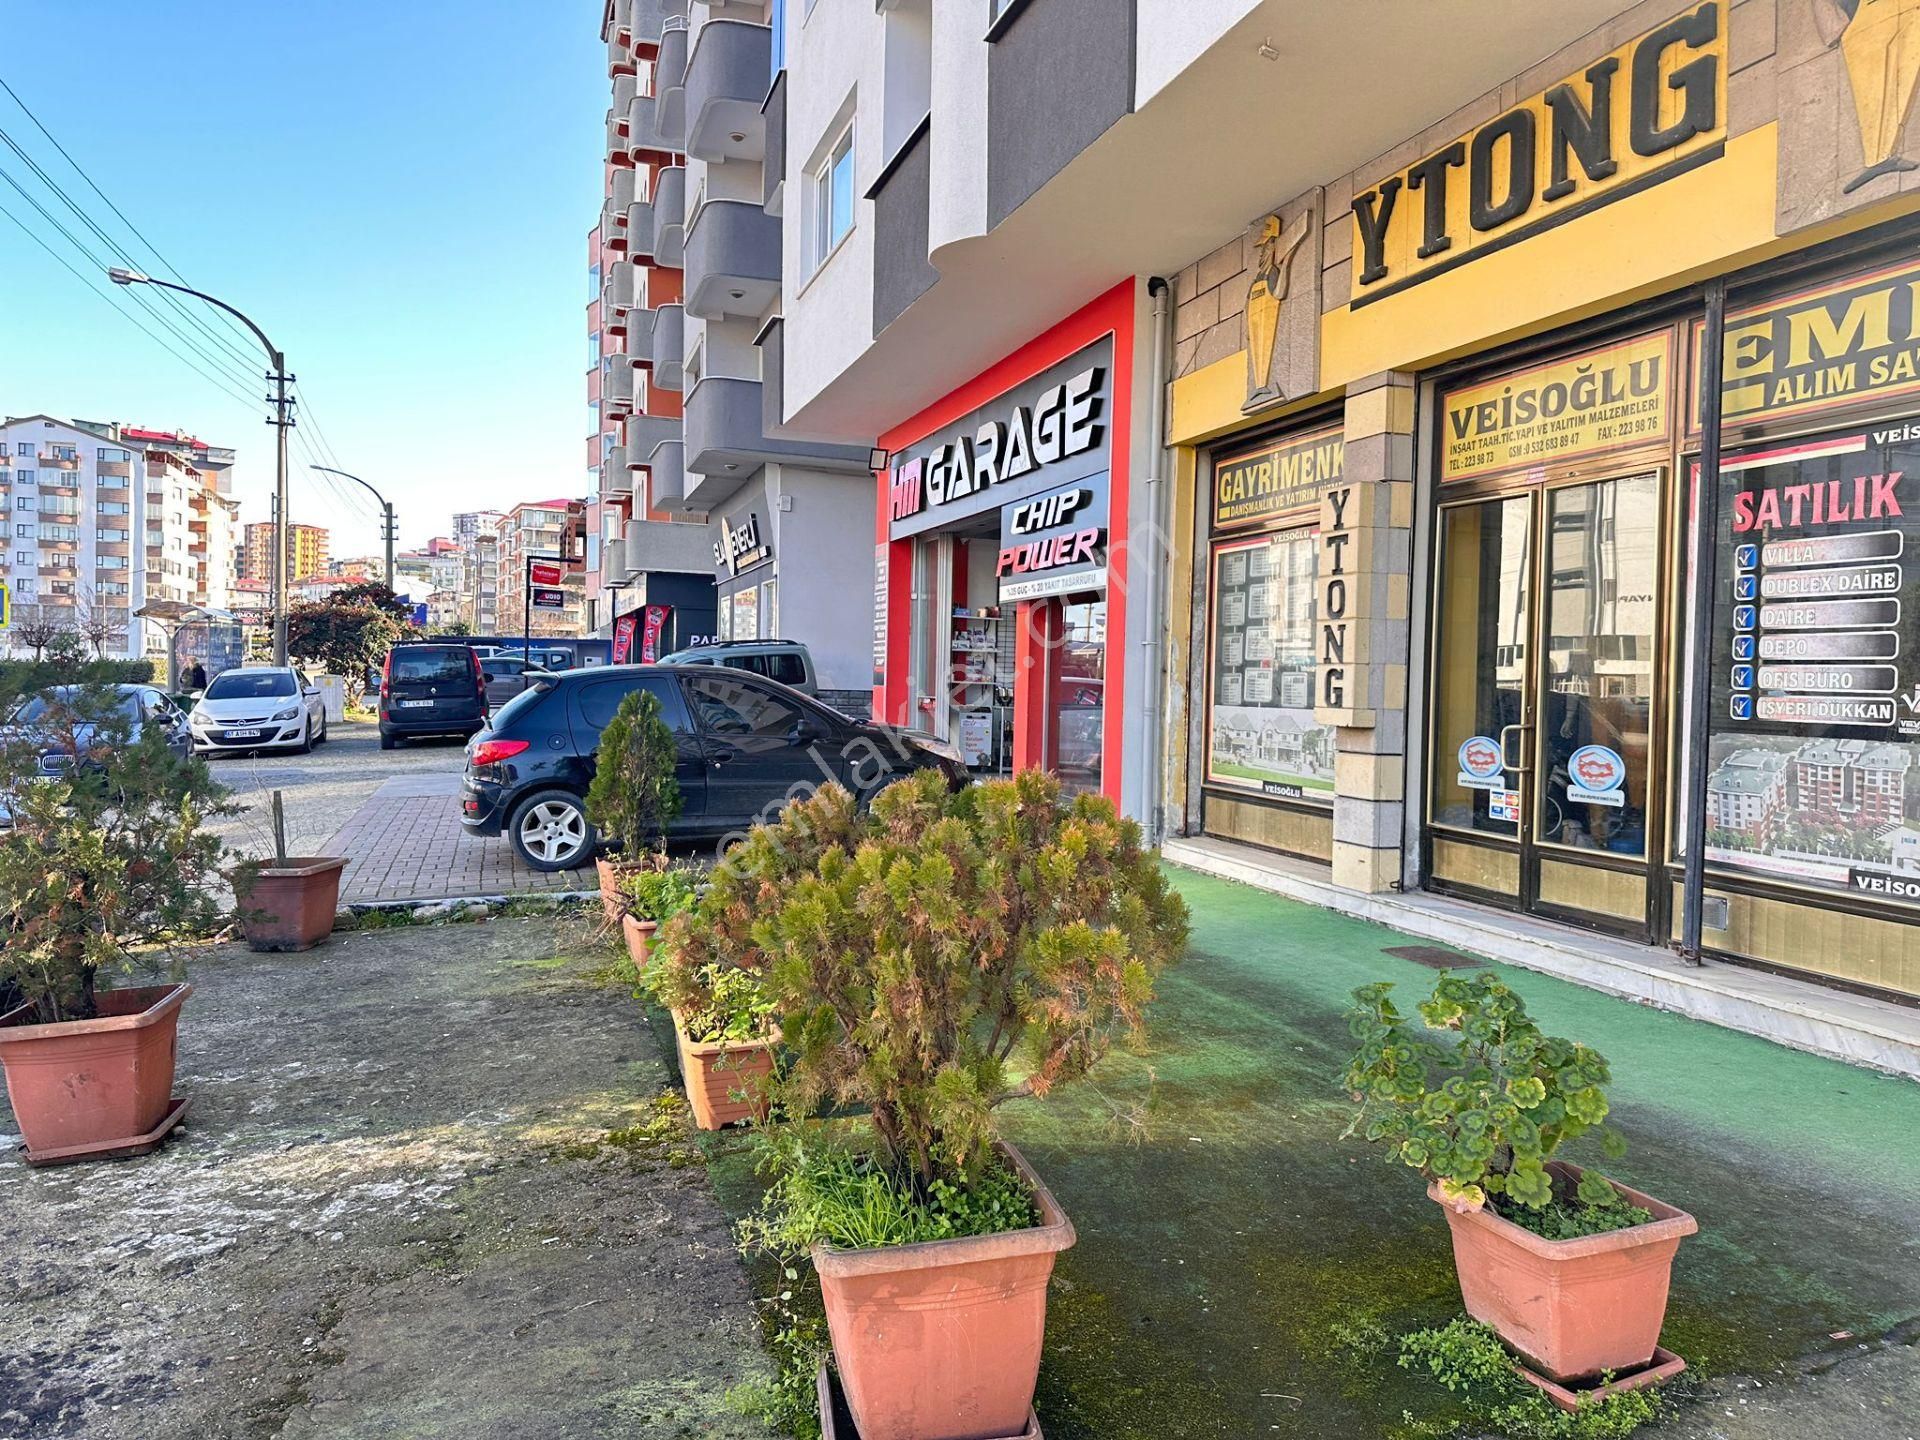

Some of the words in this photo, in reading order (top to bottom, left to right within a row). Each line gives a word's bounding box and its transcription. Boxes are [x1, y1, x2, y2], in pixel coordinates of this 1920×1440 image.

[1351, 6, 1719, 286] YTONG
[1450, 355, 1662, 440] VEİSOĞLU
[1771, 363, 1856, 406] ALIM
[1868, 348, 1920, 386] SA
[926, 367, 1100, 506] GARAGE
[1450, 439, 1476, 456] İNŞAAT
[1537, 423, 1548, 435] VE
[1549, 415, 1586, 433] YALITIM
[1588, 394, 1660, 424] MALZEMELERİ
[1531, 440, 1544, 454] 532
[1545, 437, 1558, 451] 683
[1558, 435, 1569, 448] 89
[1570, 432, 1580, 446] 47
[1618, 422, 1634, 437] 223
[1634, 419, 1645, 433] 98
[1646, 416, 1658, 430] 76
[1464, 456, 1476, 468] 223
[1476, 454, 1485, 466] 98
[1485, 452, 1494, 464] 73
[1010, 488, 1081, 535] CHIP
[1733, 471, 1904, 533] SATILIK
[996, 526, 1100, 577] POWER
[1323, 488, 1350, 709] YTONG
[1838, 568, 1896, 591] DAİRE
[1764, 607, 1816, 626] DAİRE
[1764, 638, 1808, 656] DEPO
[1763, 667, 1800, 689] OFİS
[1804, 667, 1854, 689] BÜRO
[1818, 698, 1892, 719] DÜKKAN
